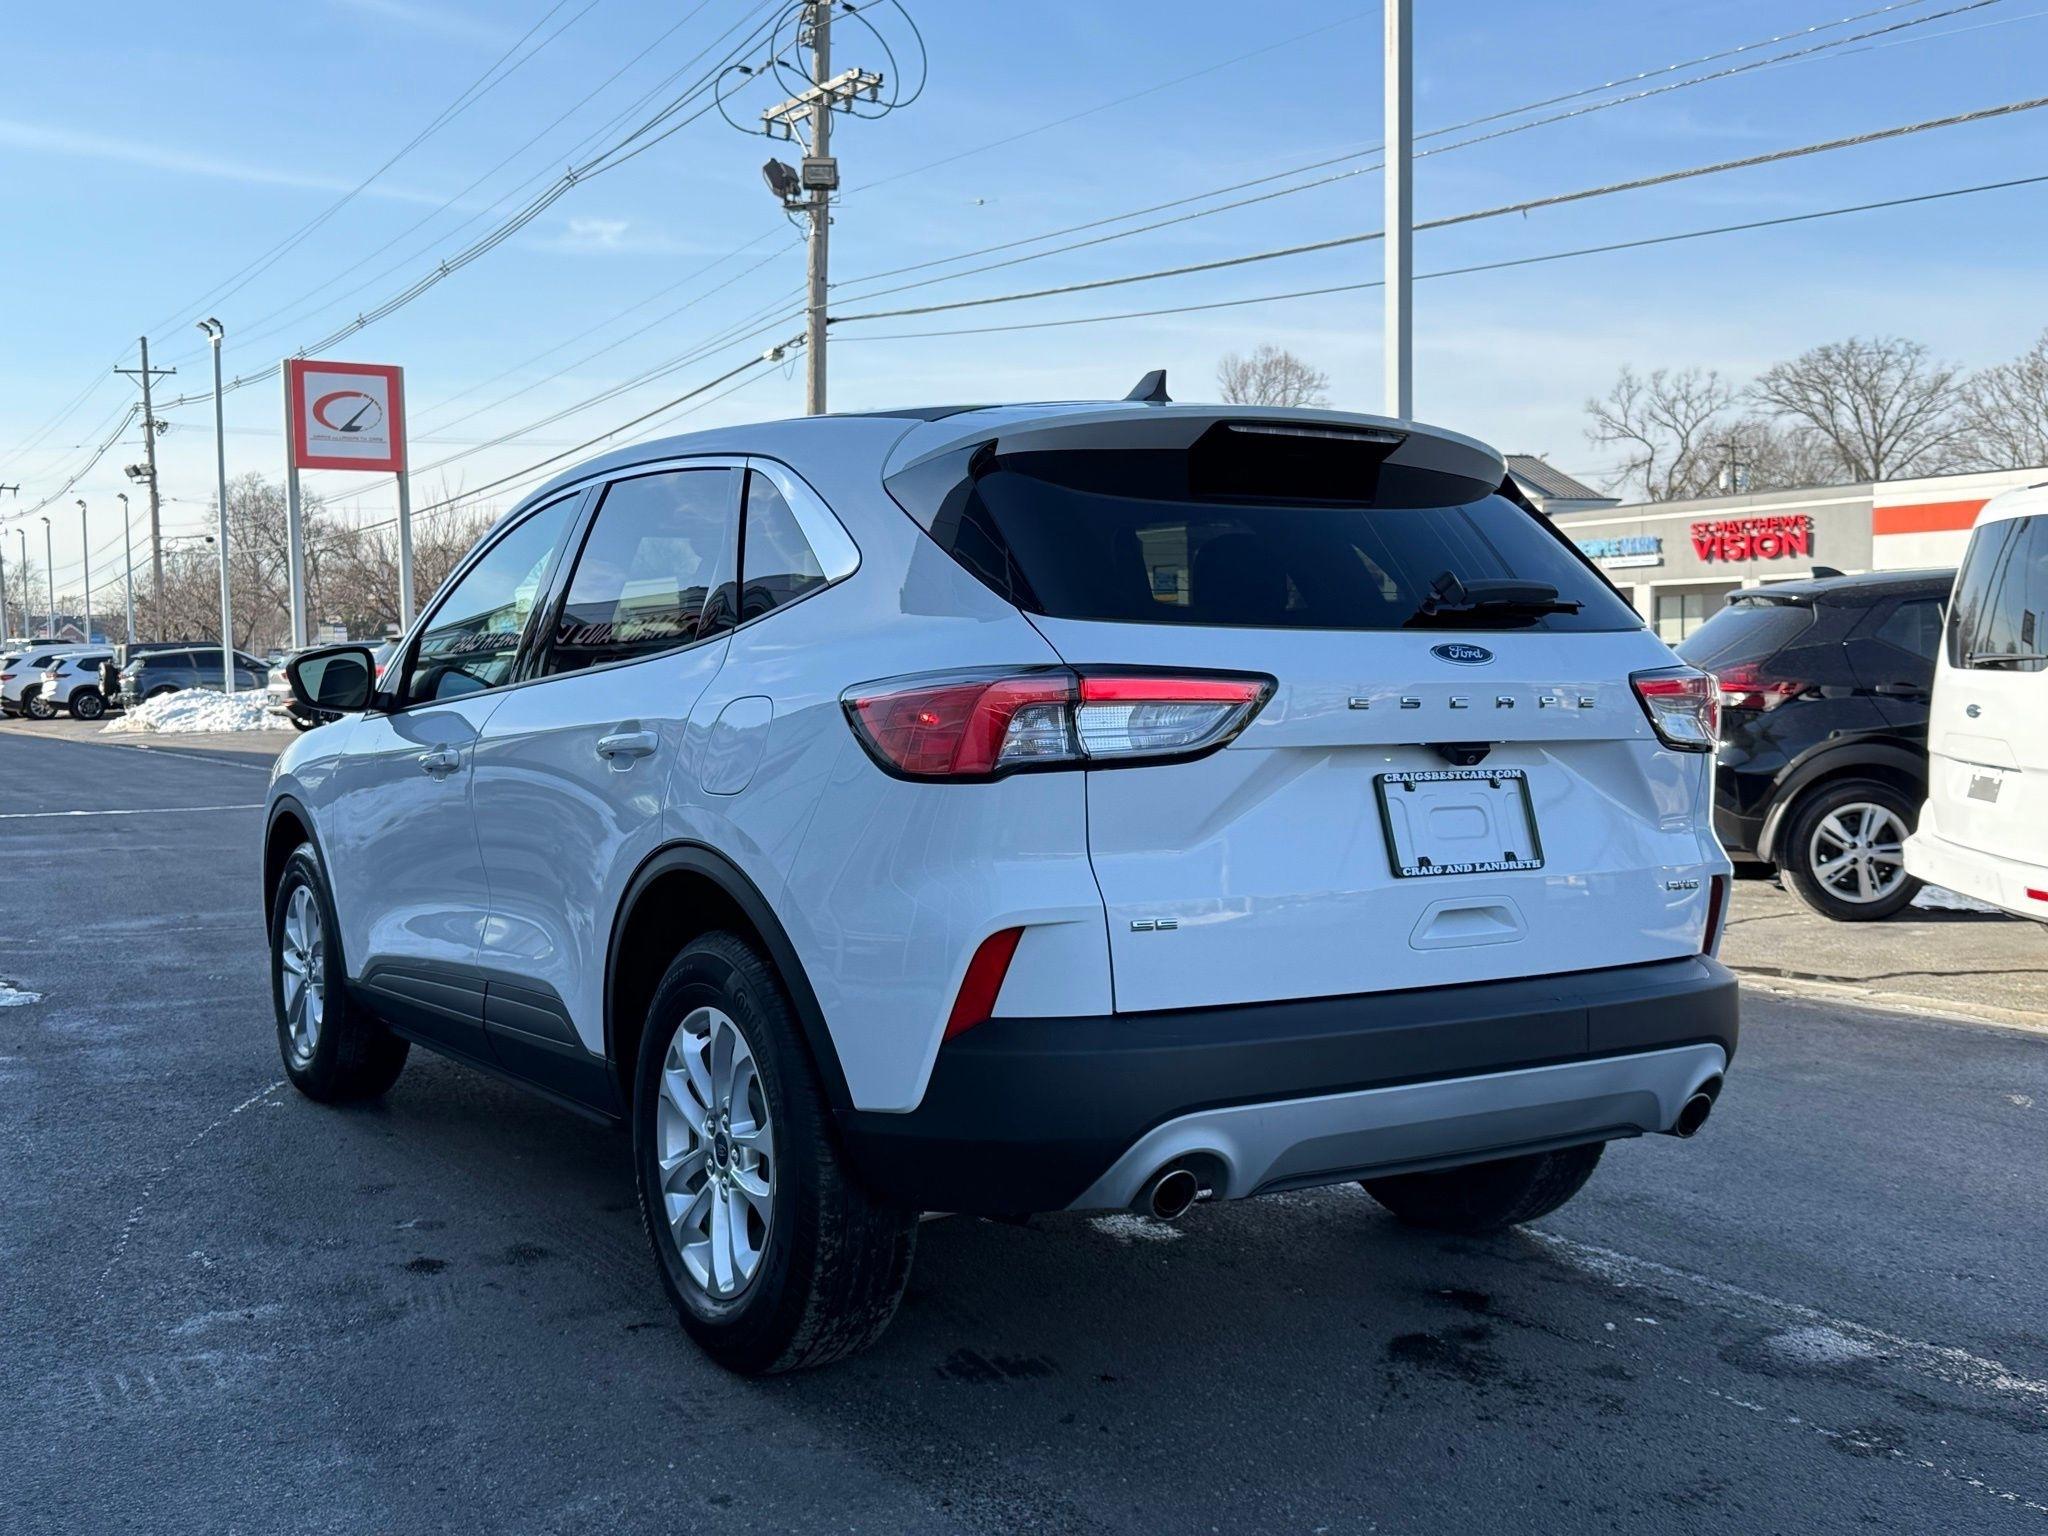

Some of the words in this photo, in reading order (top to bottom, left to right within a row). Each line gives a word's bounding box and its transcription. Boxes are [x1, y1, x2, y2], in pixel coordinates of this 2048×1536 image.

[1714, 514, 1808, 535] MATTHEWS
[1691, 531, 1809, 561] VISION
[1447, 645, 1484, 660] Ford
[1348, 696, 1596, 710] ESCAPE
[1384, 769, 1522, 782] CRAIGSBESTCARS.COM
[1402, 866, 1443, 877] CRAIG
[1445, 864, 1473, 875] AND
[1475, 859, 1541, 872] LANDRETH
[1130, 919, 1178, 932] SE
